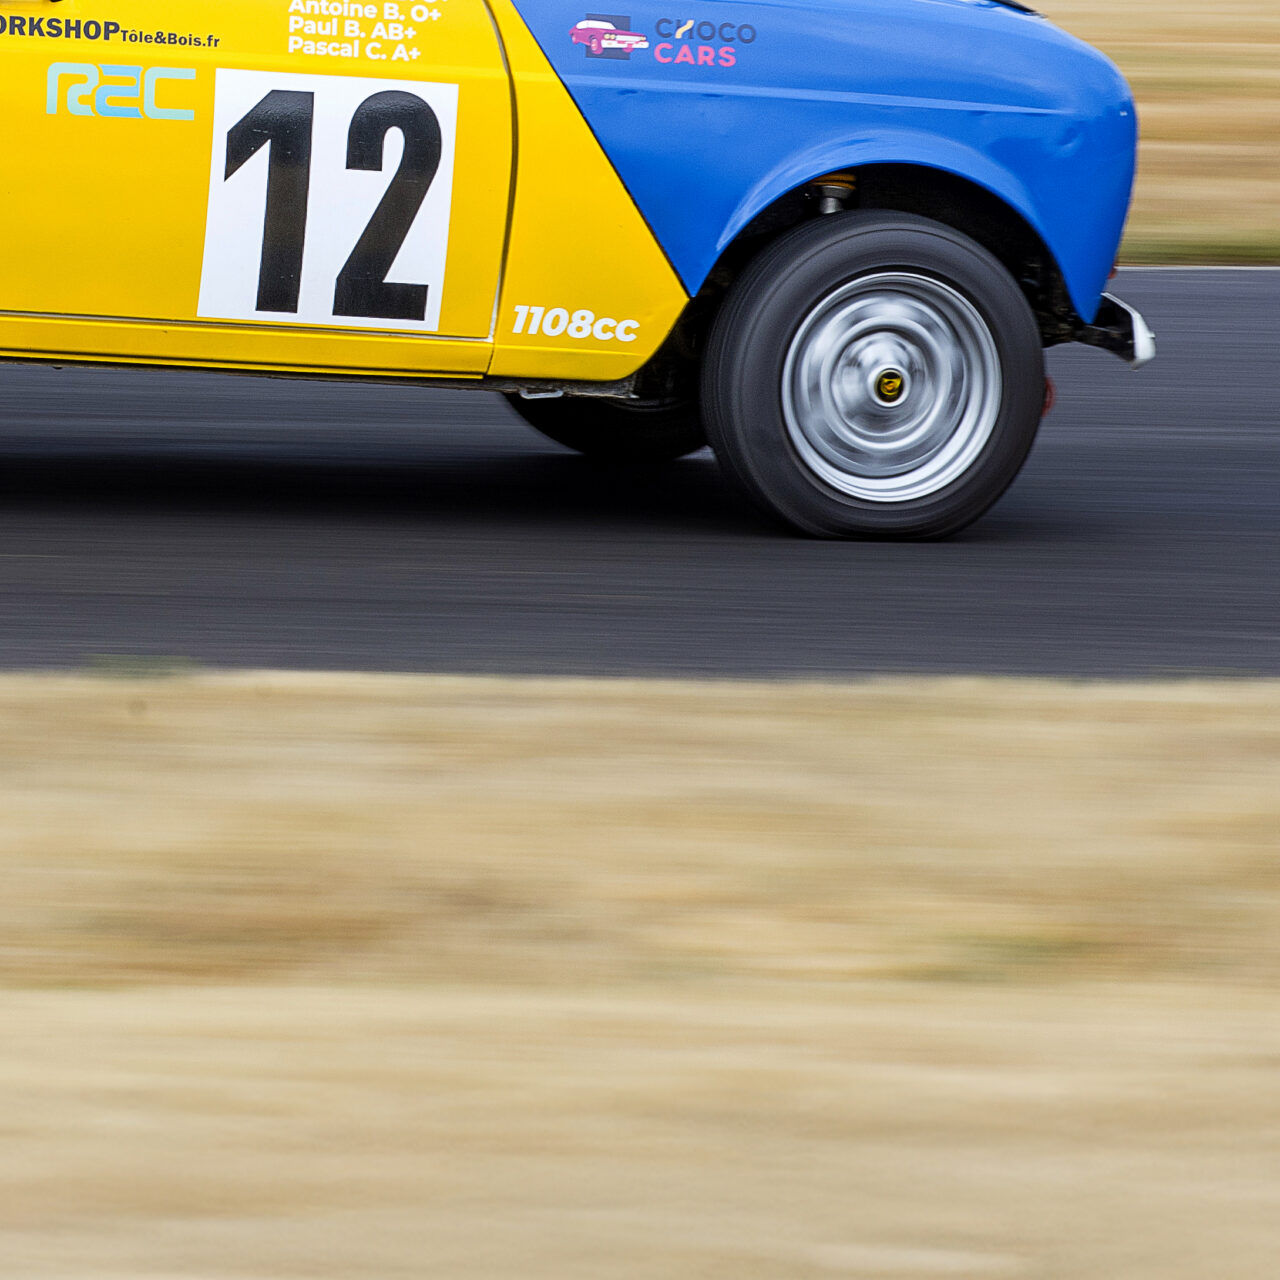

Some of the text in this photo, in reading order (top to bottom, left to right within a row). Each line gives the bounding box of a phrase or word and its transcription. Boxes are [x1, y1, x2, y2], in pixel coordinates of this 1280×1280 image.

[383, 3, 405, 21] B.
[410, 5, 442, 22] O+
[288, 15, 417, 41] Paul B. AB+
[655, 18, 757, 45] CHOCO
[288, 36, 421, 62] Pascal C. A+
[654, 42, 737, 67] CARS
[224, 89, 442, 321] 12
[511, 304, 641, 342] 1108cc
